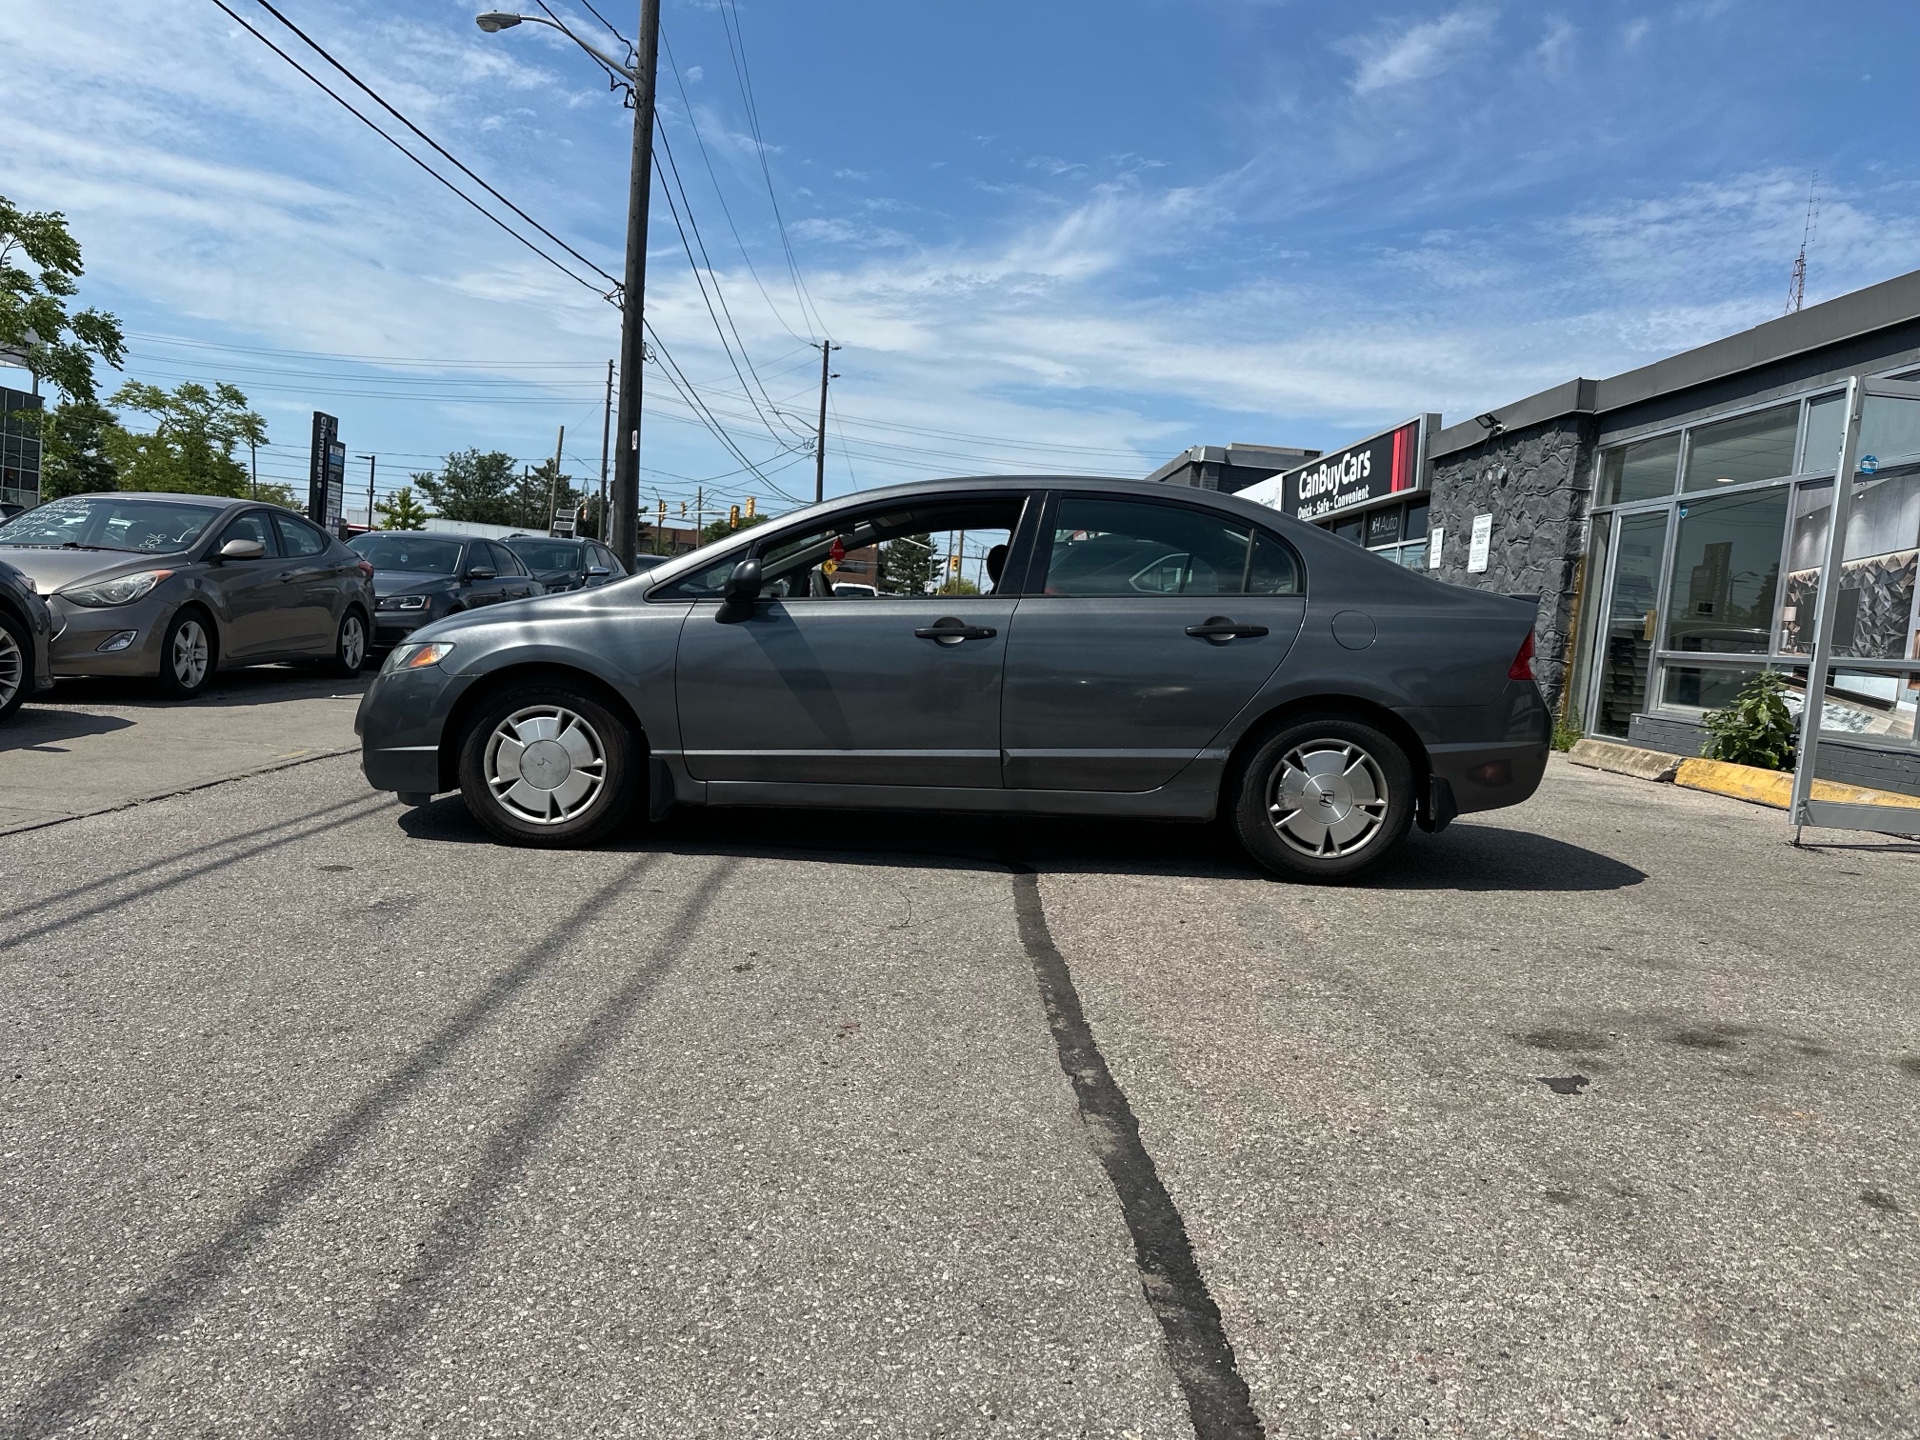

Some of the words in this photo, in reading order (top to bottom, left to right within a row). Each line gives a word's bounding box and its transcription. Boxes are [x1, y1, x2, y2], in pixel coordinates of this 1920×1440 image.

[317, 416, 327, 489] Champagne
[1299, 450, 1371, 500] CanBuyCars
[1298, 503, 1312, 519] Quick
[1316, 498, 1329, 514] Safe
[1333, 484, 1370, 509] Convenient
[1380, 515, 1398, 532] Auto
